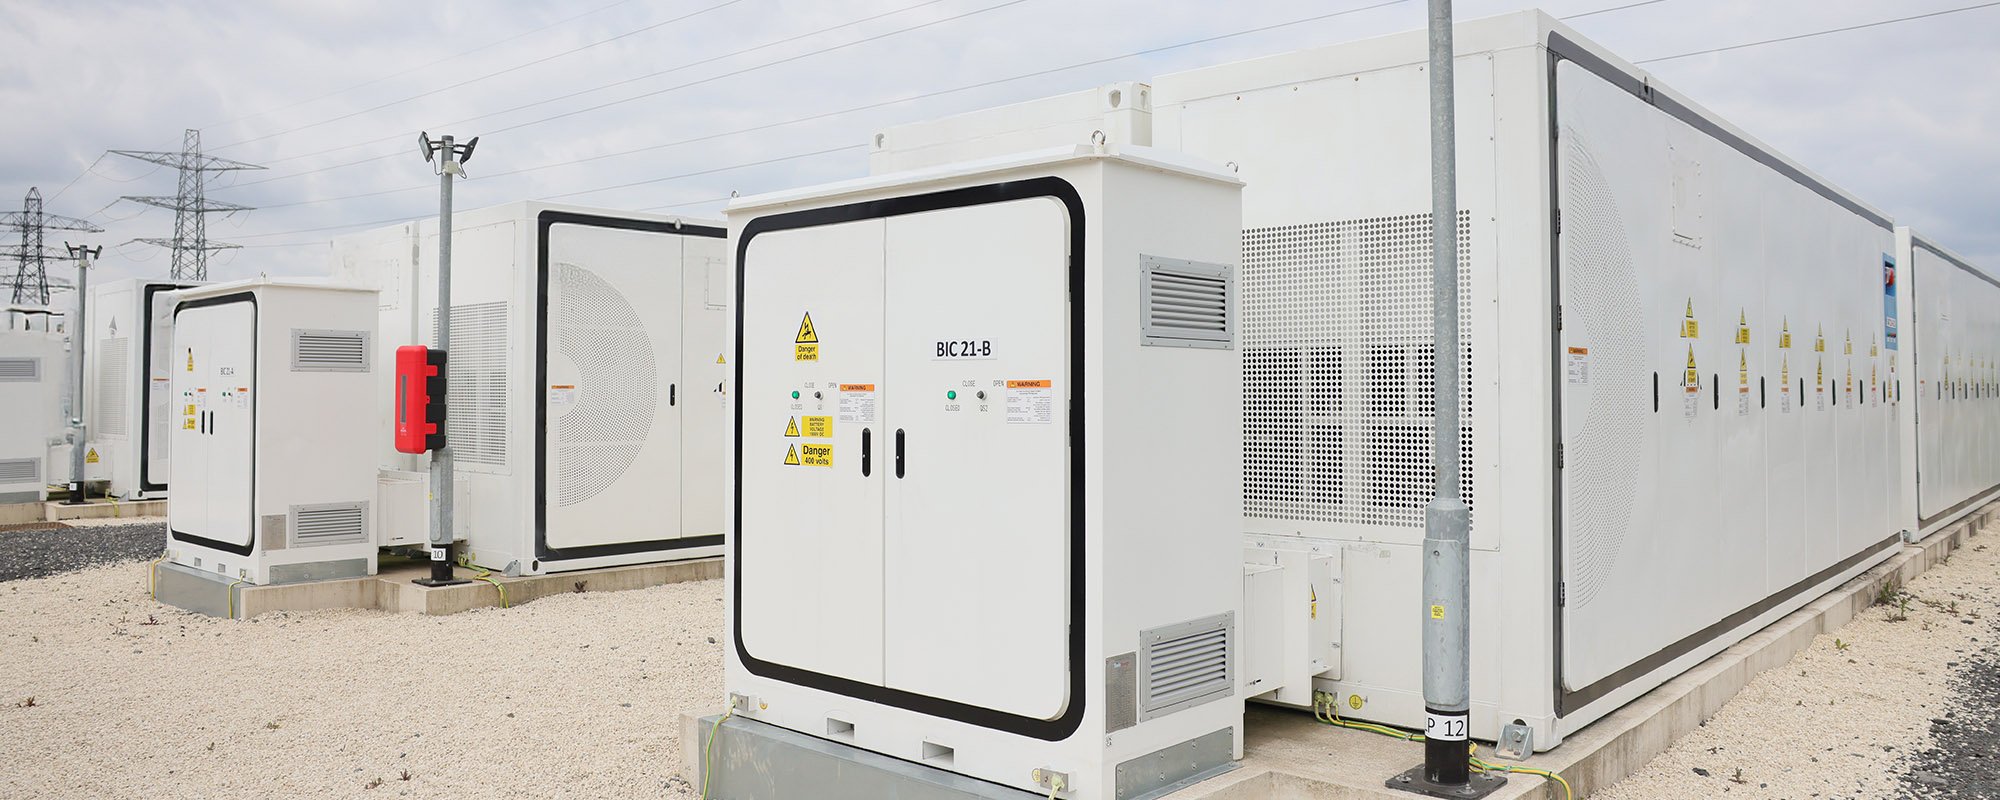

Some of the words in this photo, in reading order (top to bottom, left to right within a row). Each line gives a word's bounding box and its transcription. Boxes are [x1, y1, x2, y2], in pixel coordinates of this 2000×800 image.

[798, 345, 816, 354] Danger
[936, 341, 958, 357] BIC
[960, 340, 991, 357] 21-B
[962, 379, 976, 387] CLOSE
[945, 404, 960, 412] CLOSED
[803, 445, 831, 457] Danger
[433, 550, 444, 559] 10
[1425, 717, 1435, 733] P
[1444, 720, 1464, 736] 12
